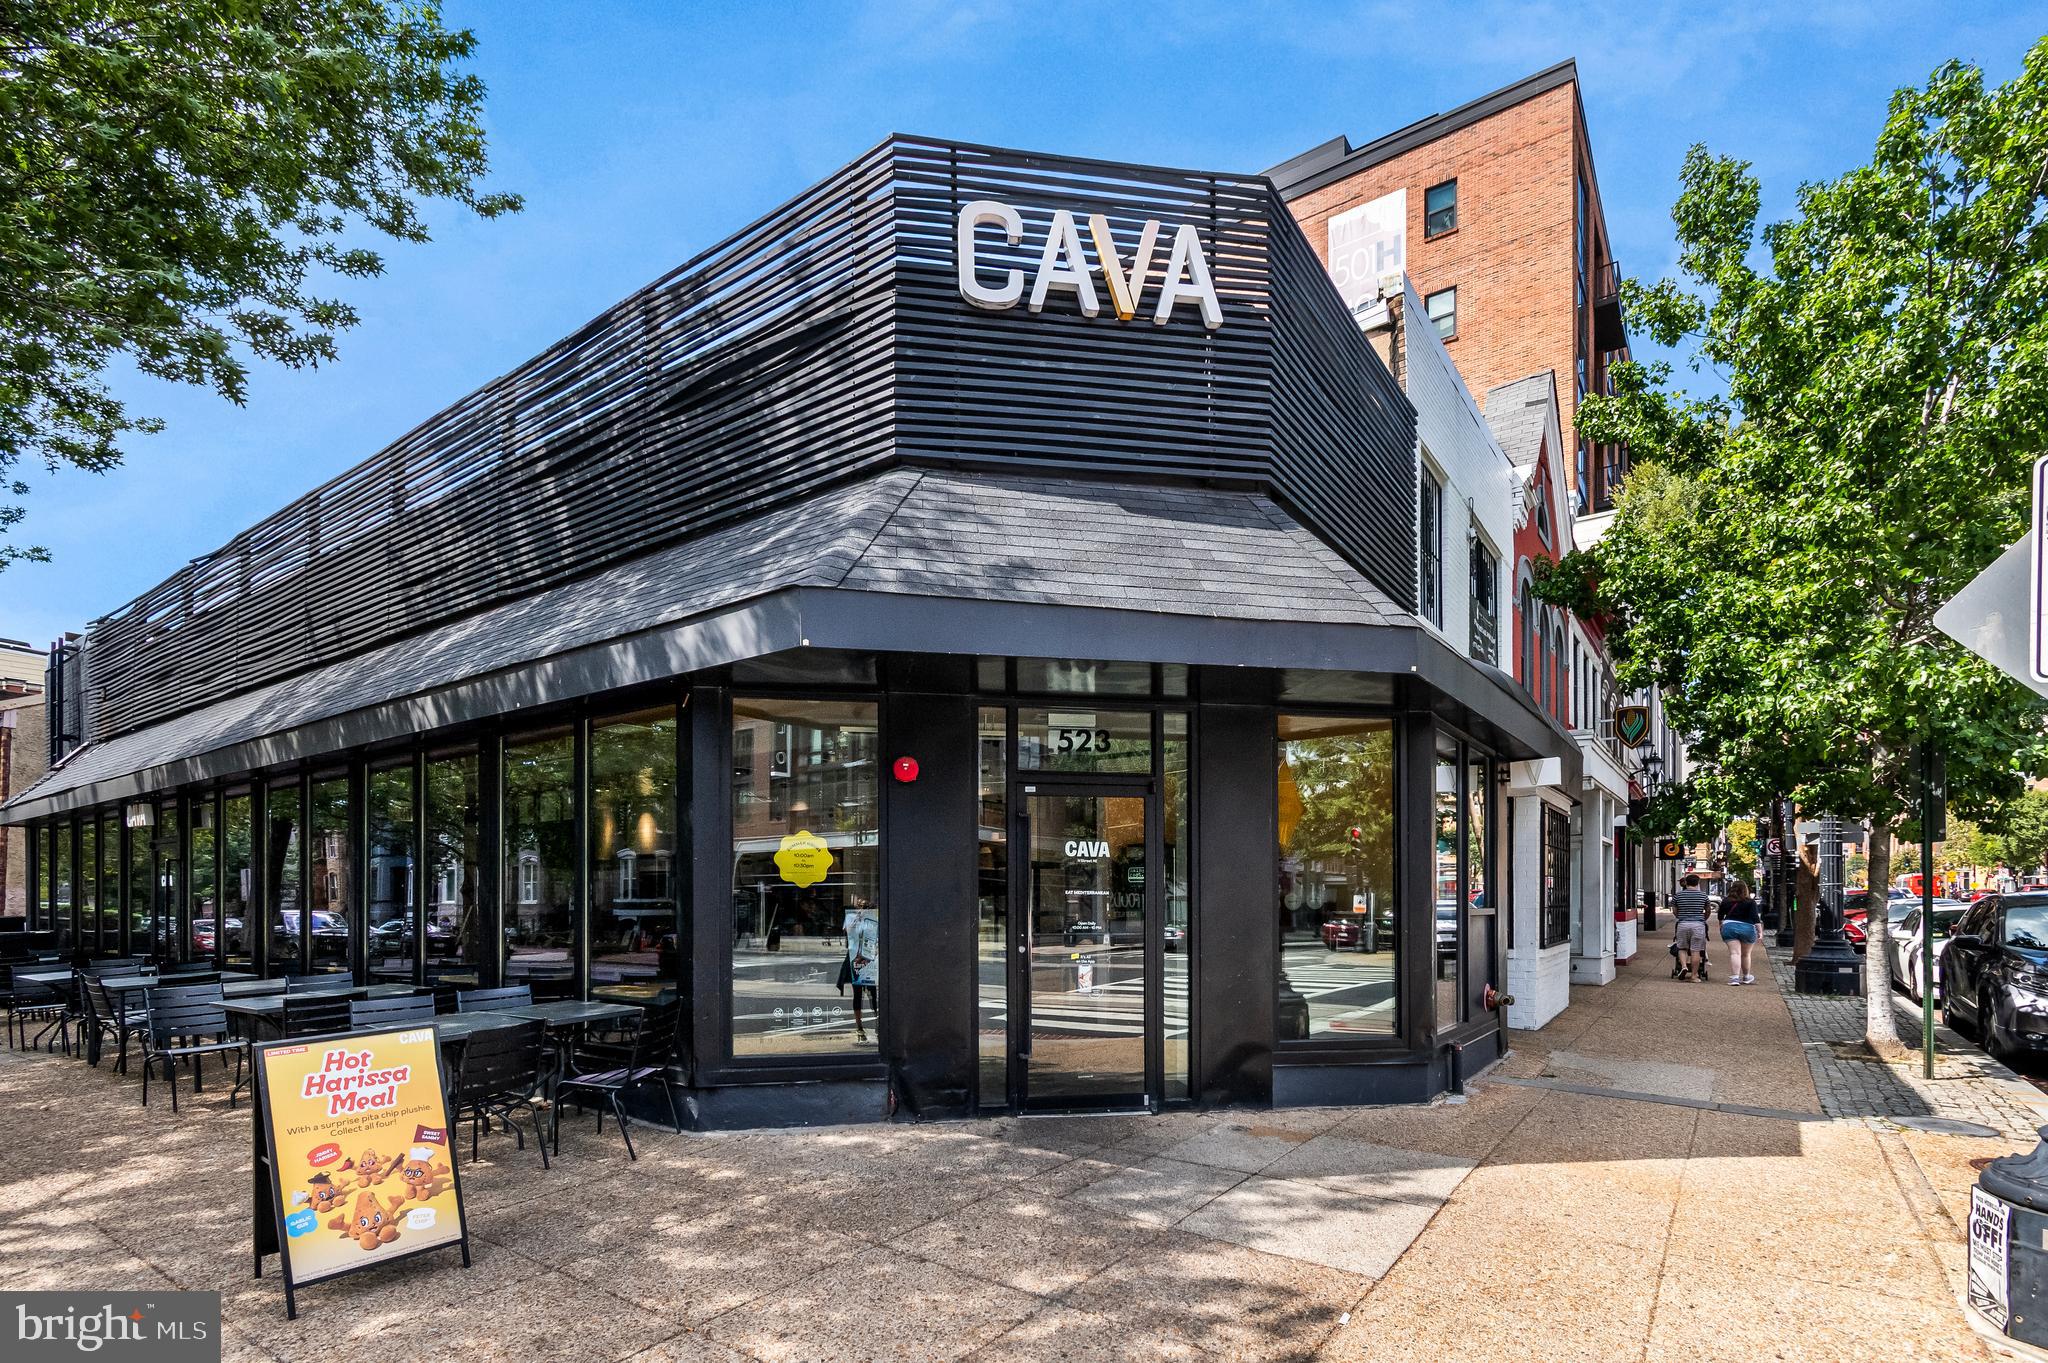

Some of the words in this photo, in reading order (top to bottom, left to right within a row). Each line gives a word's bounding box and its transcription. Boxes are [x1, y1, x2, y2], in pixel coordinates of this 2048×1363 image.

[958, 200, 1225, 331] CAVA
[1057, 729, 1111, 752] 523
[1065, 840, 1111, 858] CAVA
[399, 1031, 433, 1045] CAVA
[267, 1048, 291, 1057] LIMITED
[324, 1051, 371, 1072] Hot
[305, 1067, 408, 1096] Harissa
[330, 1086, 394, 1114] Meal
[286, 1124, 311, 1136] With
[320, 1117, 360, 1131] surprise
[361, 1113, 379, 1126] pita
[381, 1110, 399, 1122] chip
[401, 1103, 433, 1119] plushie.
[330, 1125, 362, 1137] Collect
[364, 1122, 375, 1131] all
[376, 1119, 397, 1130] four!
[1975, 1203, 2004, 1231] HANDS
[1972, 1219, 2002, 1253] OFF!
[1992, 1249, 2003, 1262] STOP
